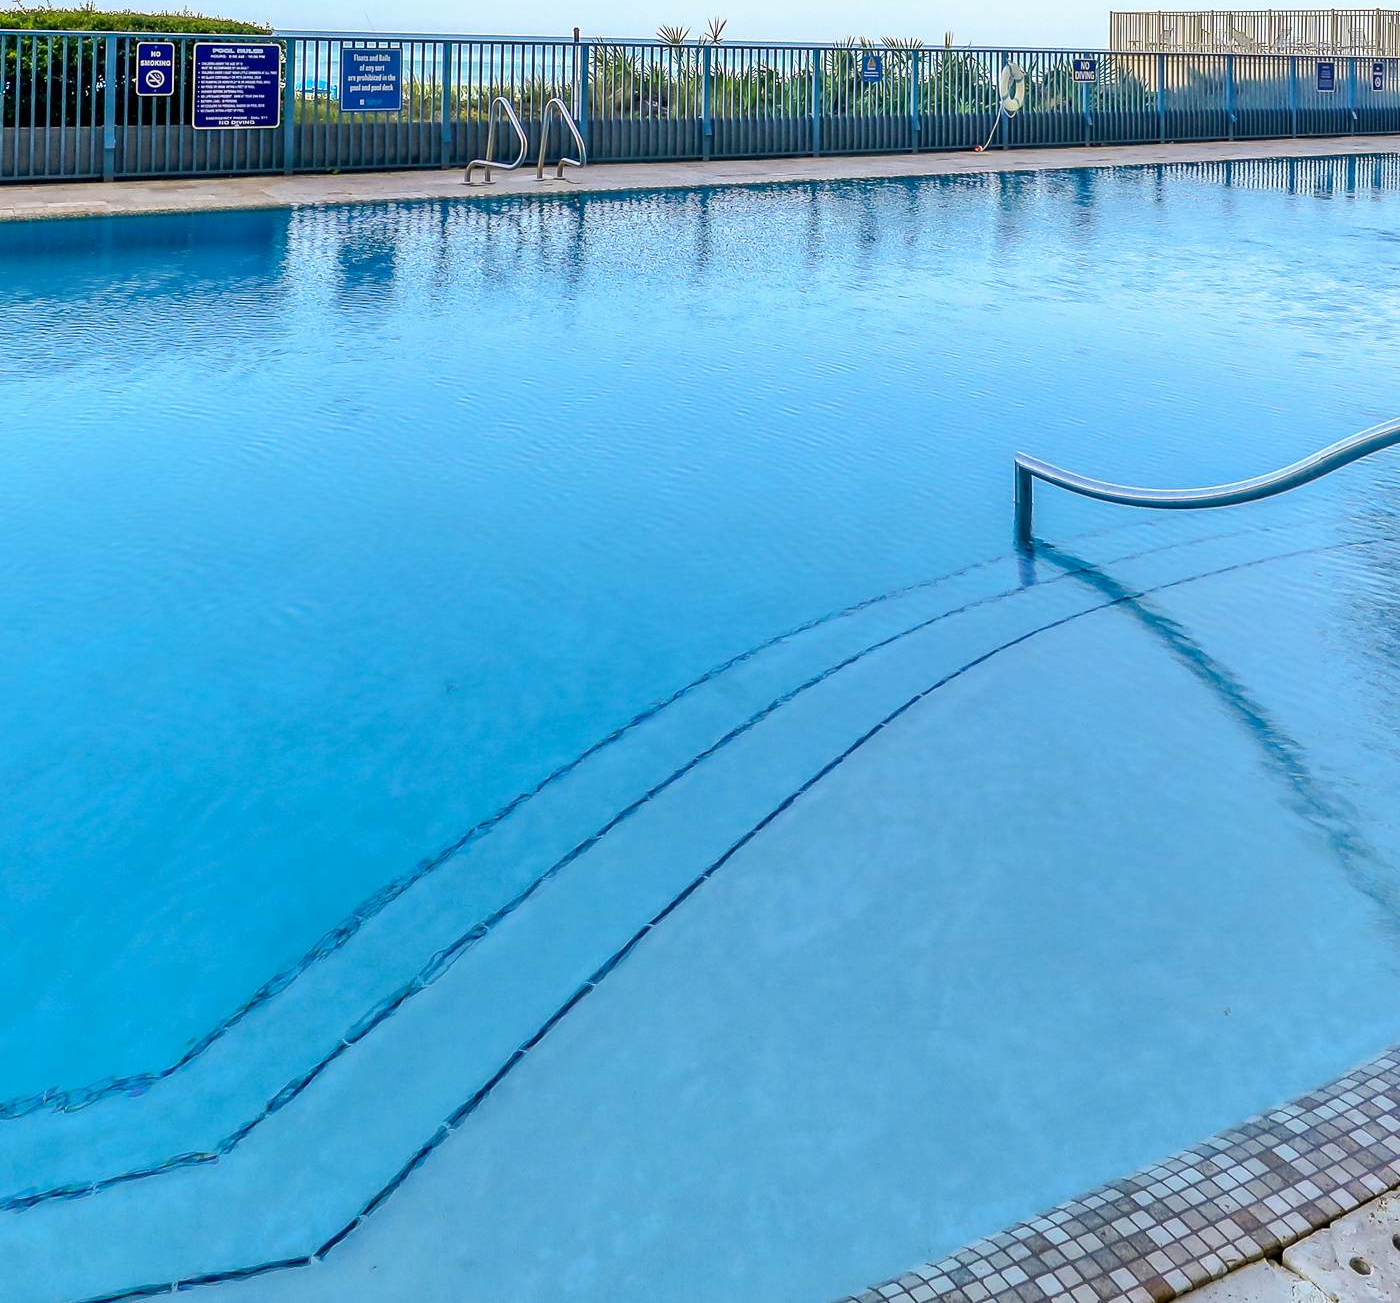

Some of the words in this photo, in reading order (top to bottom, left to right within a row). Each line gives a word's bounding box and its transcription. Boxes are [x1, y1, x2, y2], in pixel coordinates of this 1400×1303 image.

[1080, 61, 1090, 70] NO
[356, 74, 381, 82] prohibited
[1075, 71, 1095, 80] DIVING
[350, 84, 361, 92] pool
[371, 84, 381, 92] pool
